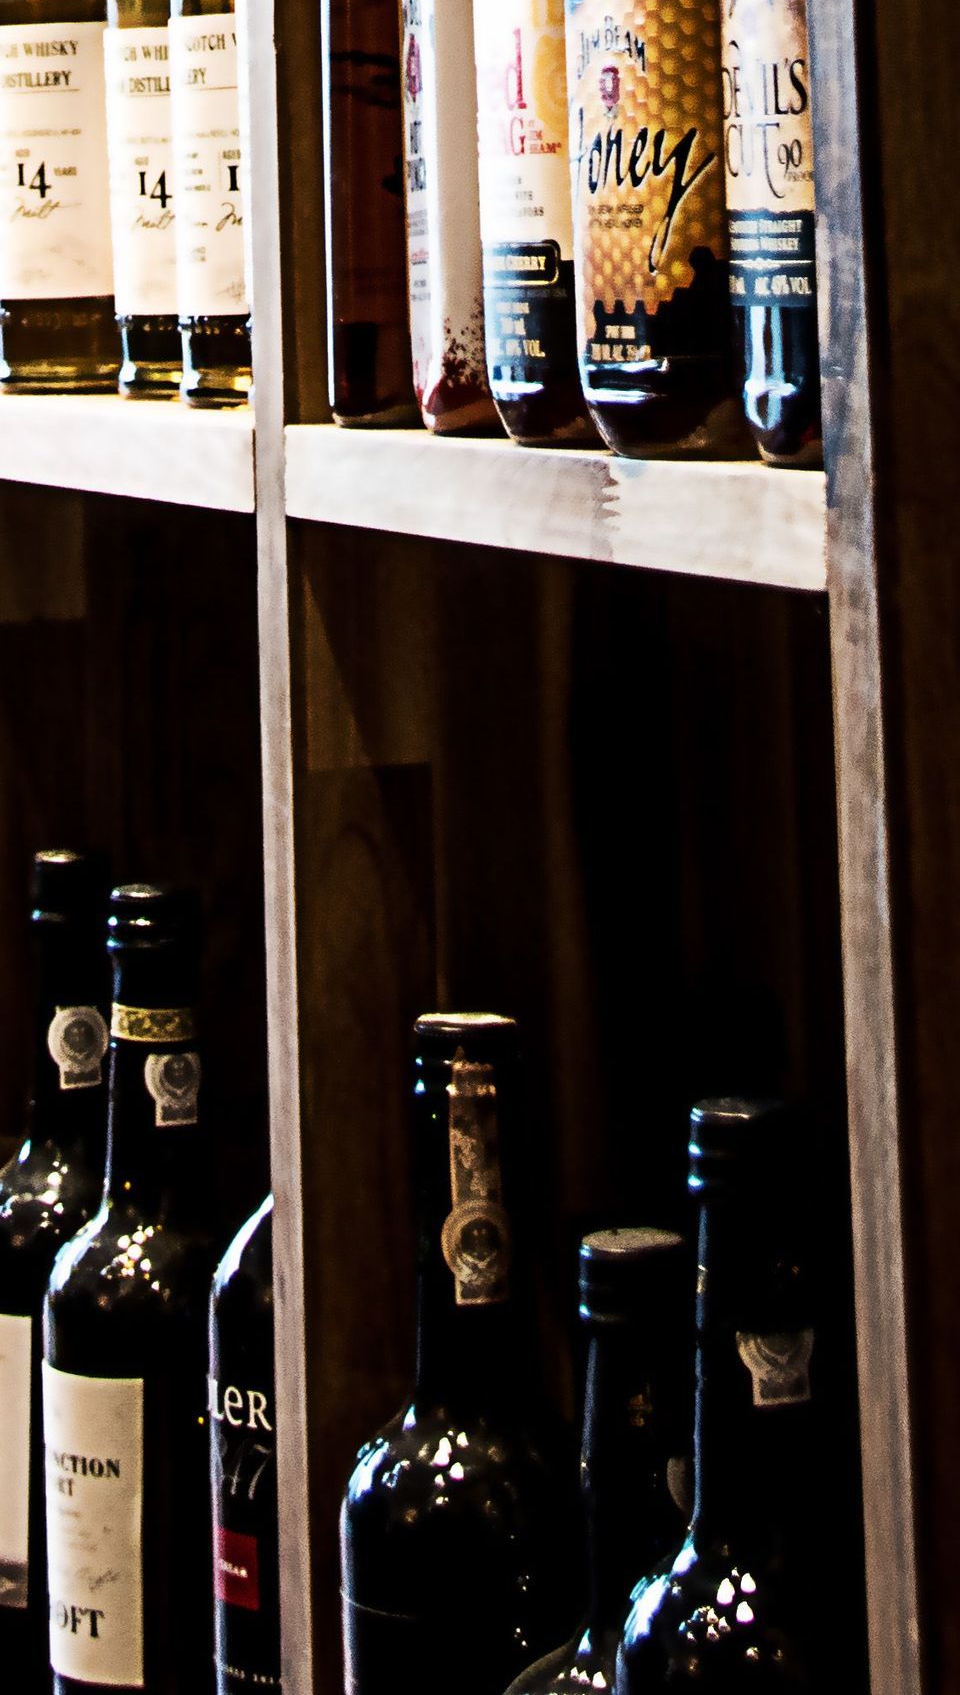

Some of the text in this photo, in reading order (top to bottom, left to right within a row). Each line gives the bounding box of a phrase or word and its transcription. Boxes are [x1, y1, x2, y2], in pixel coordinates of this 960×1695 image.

[23, 40, 79, 58] WHISKY
[721, 56, 810, 121] DEVIL'S
[17, 160, 53, 199] 14
[725, 121, 803, 200] CUT 90
[138, 168, 173, 210] 14
